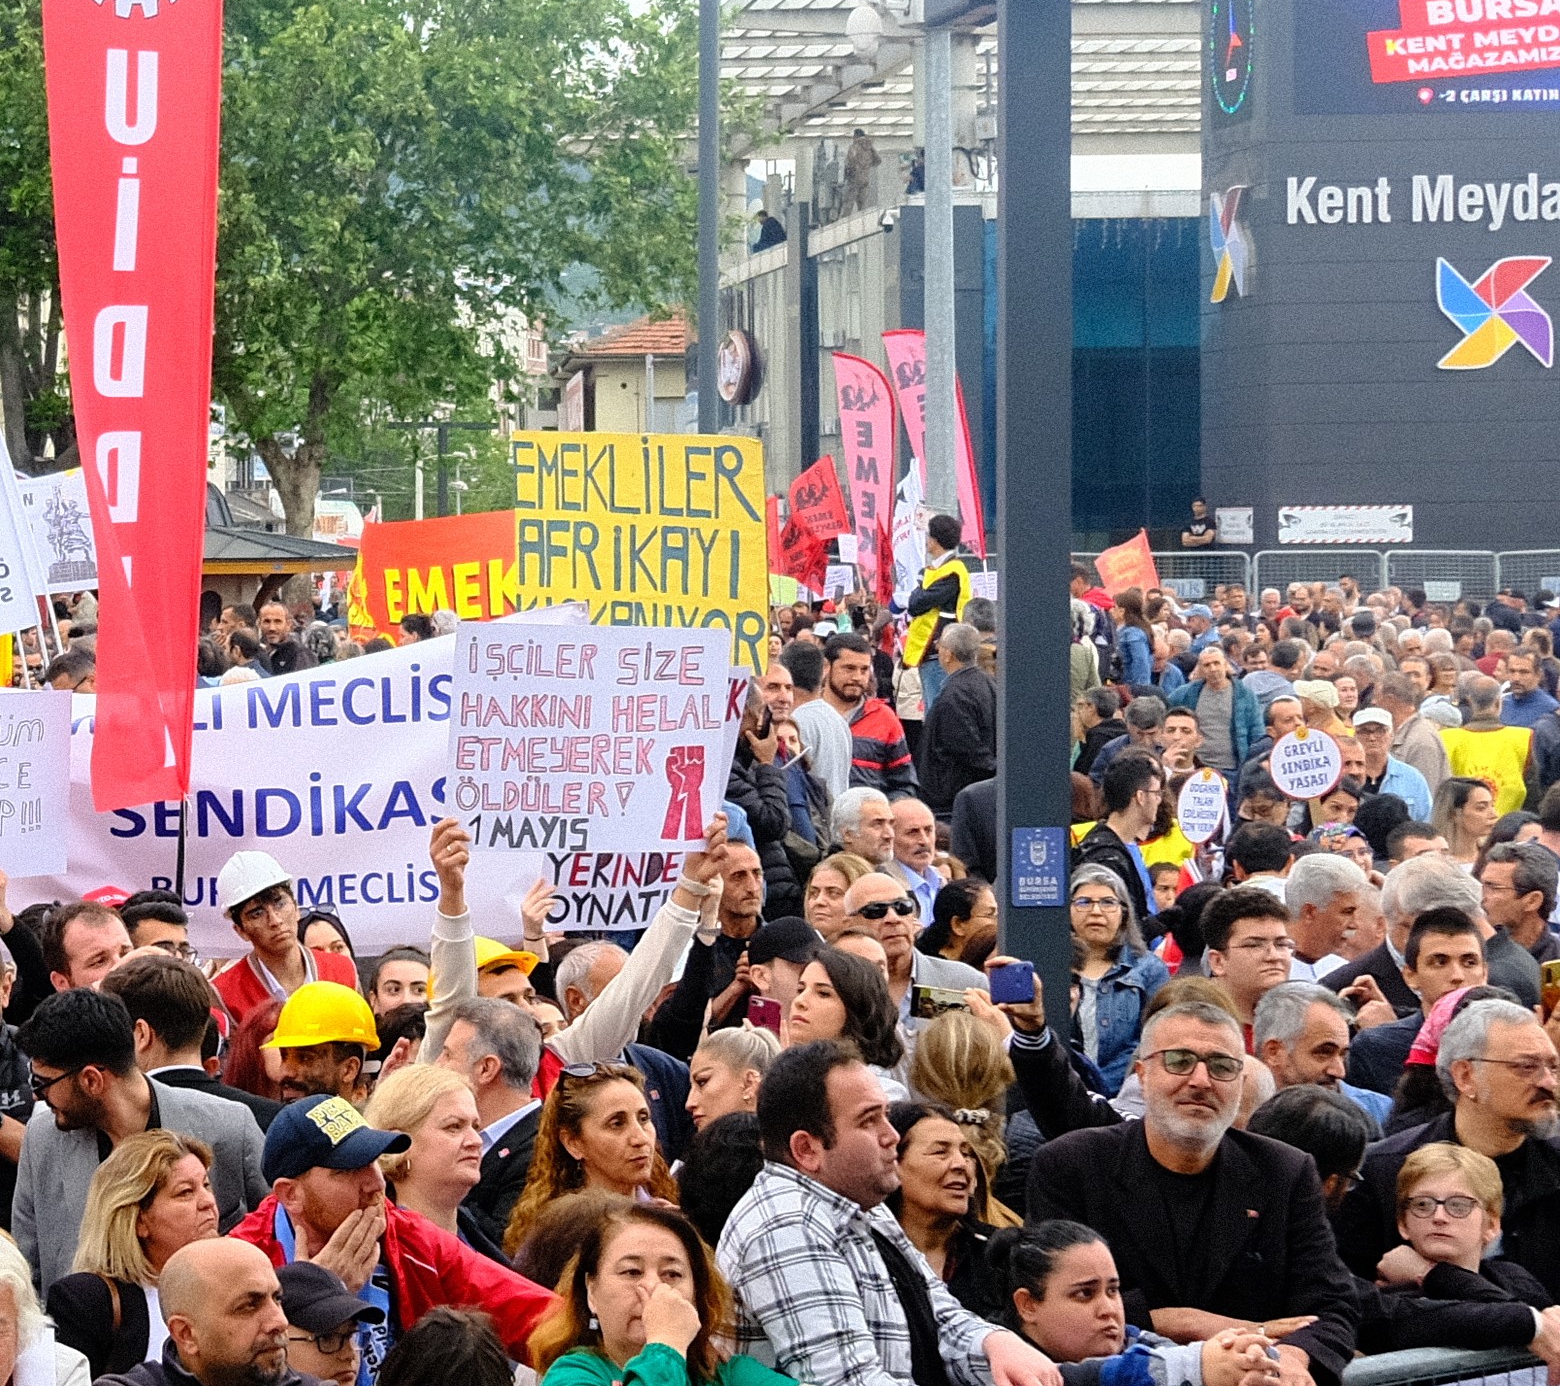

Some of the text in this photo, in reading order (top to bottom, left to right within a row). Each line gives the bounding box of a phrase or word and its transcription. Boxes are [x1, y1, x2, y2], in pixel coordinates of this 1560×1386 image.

[1385, 33, 1465, 56] KENT
[1286, 175, 1391, 225] Kent
[514, 436, 760, 521] EMEKLİLER
[467, 636, 706, 687] İŞÇİLER SİZE
[460, 691, 722, 733] HAKKINI HELAL
[456, 735, 654, 777] ETMEYEREK
[489, 815, 589, 852] MAYIS
